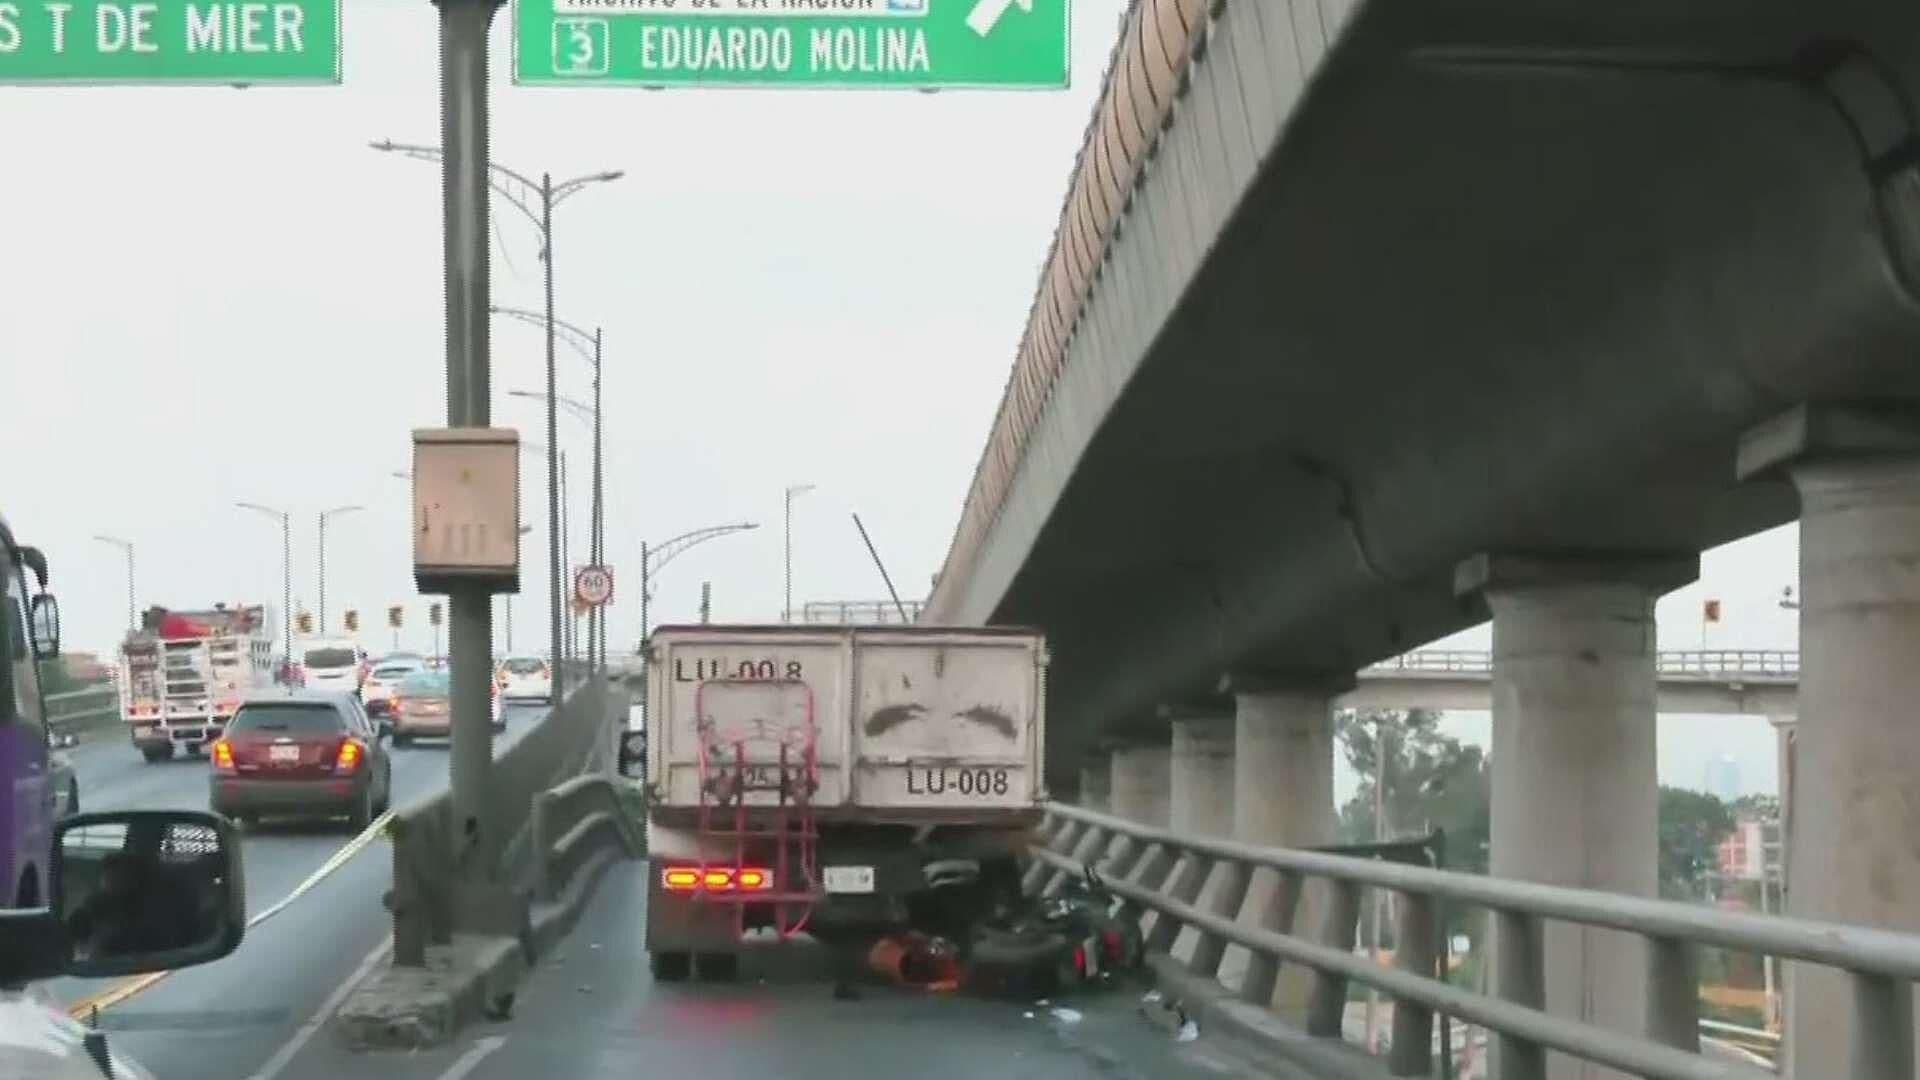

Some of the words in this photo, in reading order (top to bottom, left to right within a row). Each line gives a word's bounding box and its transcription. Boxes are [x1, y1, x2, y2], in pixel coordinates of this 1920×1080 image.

[0, 3, 21, 53] S
[44, 3, 72, 53] T
[96, 3, 159, 53] DE
[186, 3, 304, 53] MIER
[569, 31, 593, 64] 3
[641, 26, 792, 71] EDUARDO
[810, 27, 930, 72] MOLINA
[907, 766, 1008, 796] LU-008
